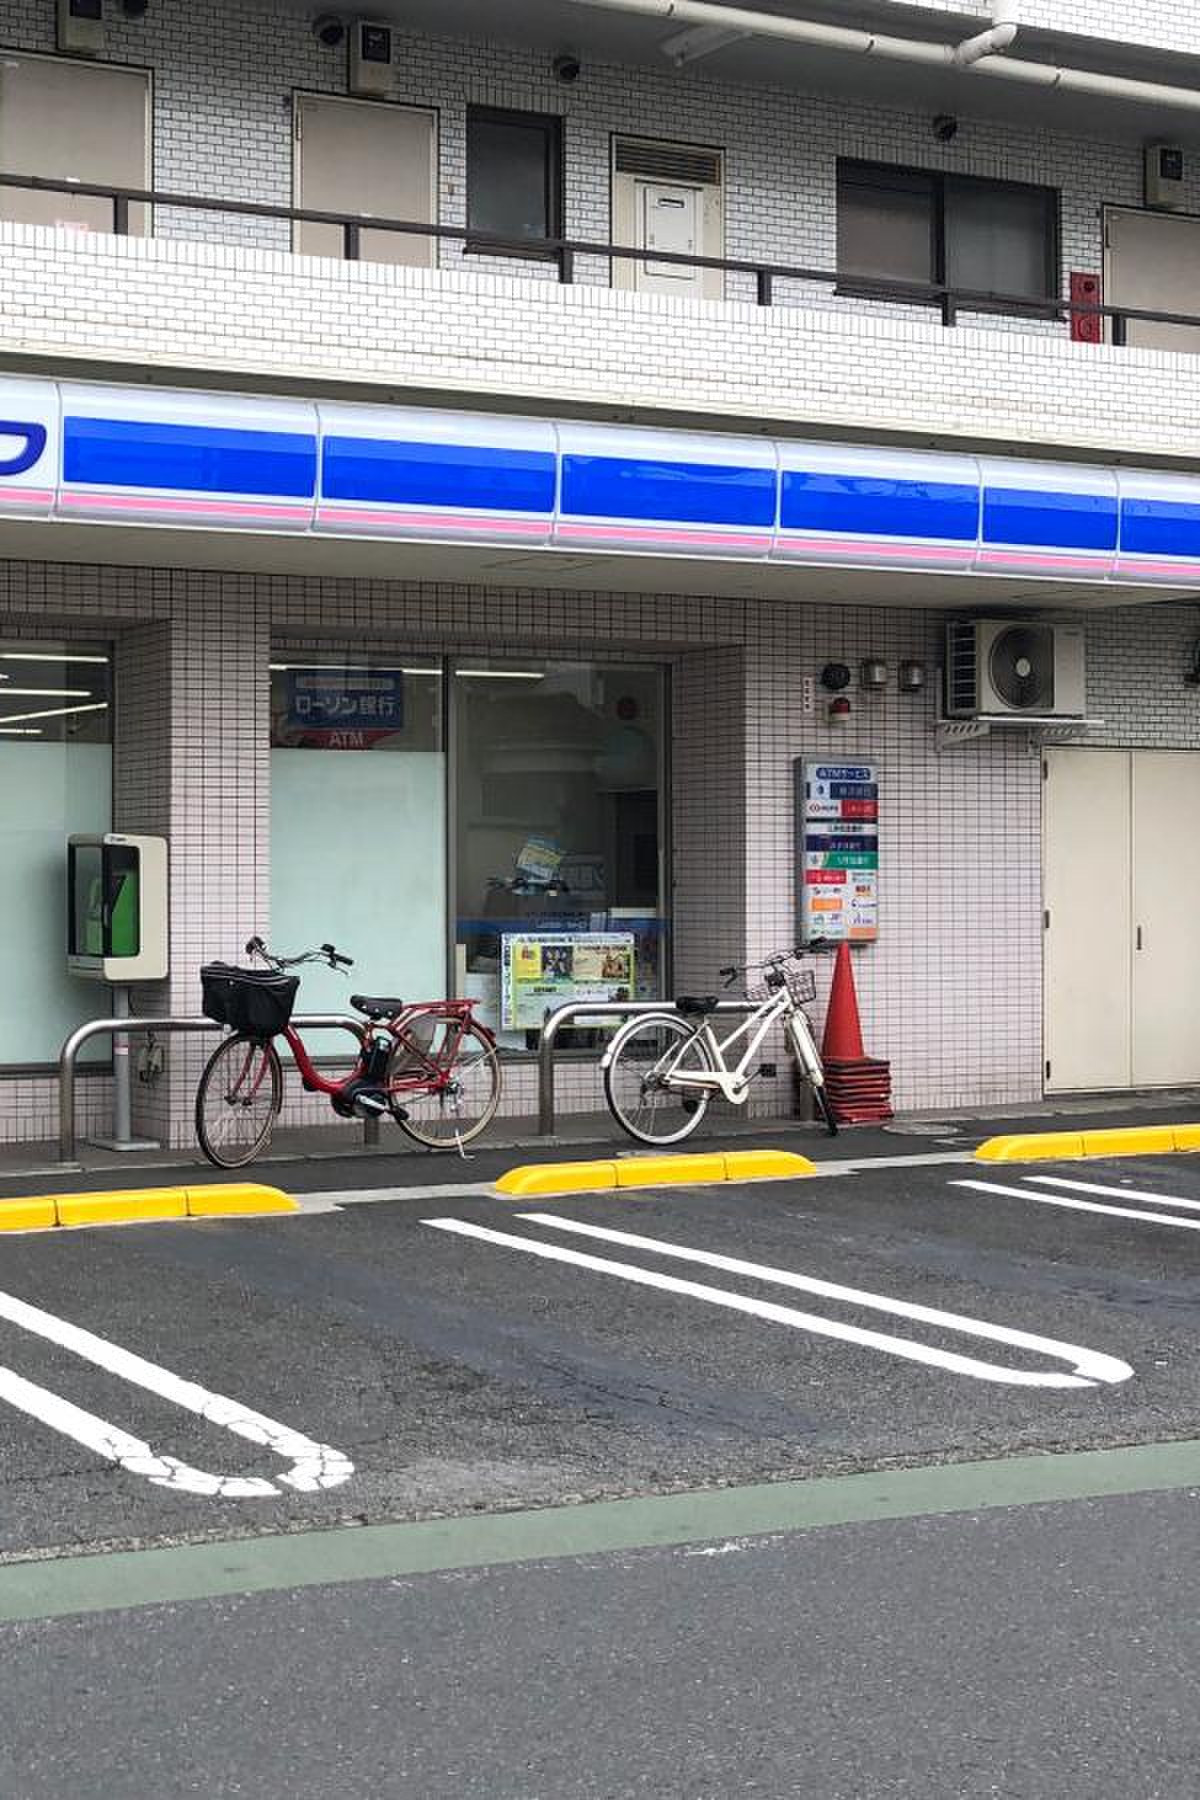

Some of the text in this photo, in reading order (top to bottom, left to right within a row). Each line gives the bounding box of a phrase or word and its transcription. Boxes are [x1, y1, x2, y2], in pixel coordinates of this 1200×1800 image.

[295, 695, 397, 716] ローソン銀行
[329, 731, 366, 748] ATM
